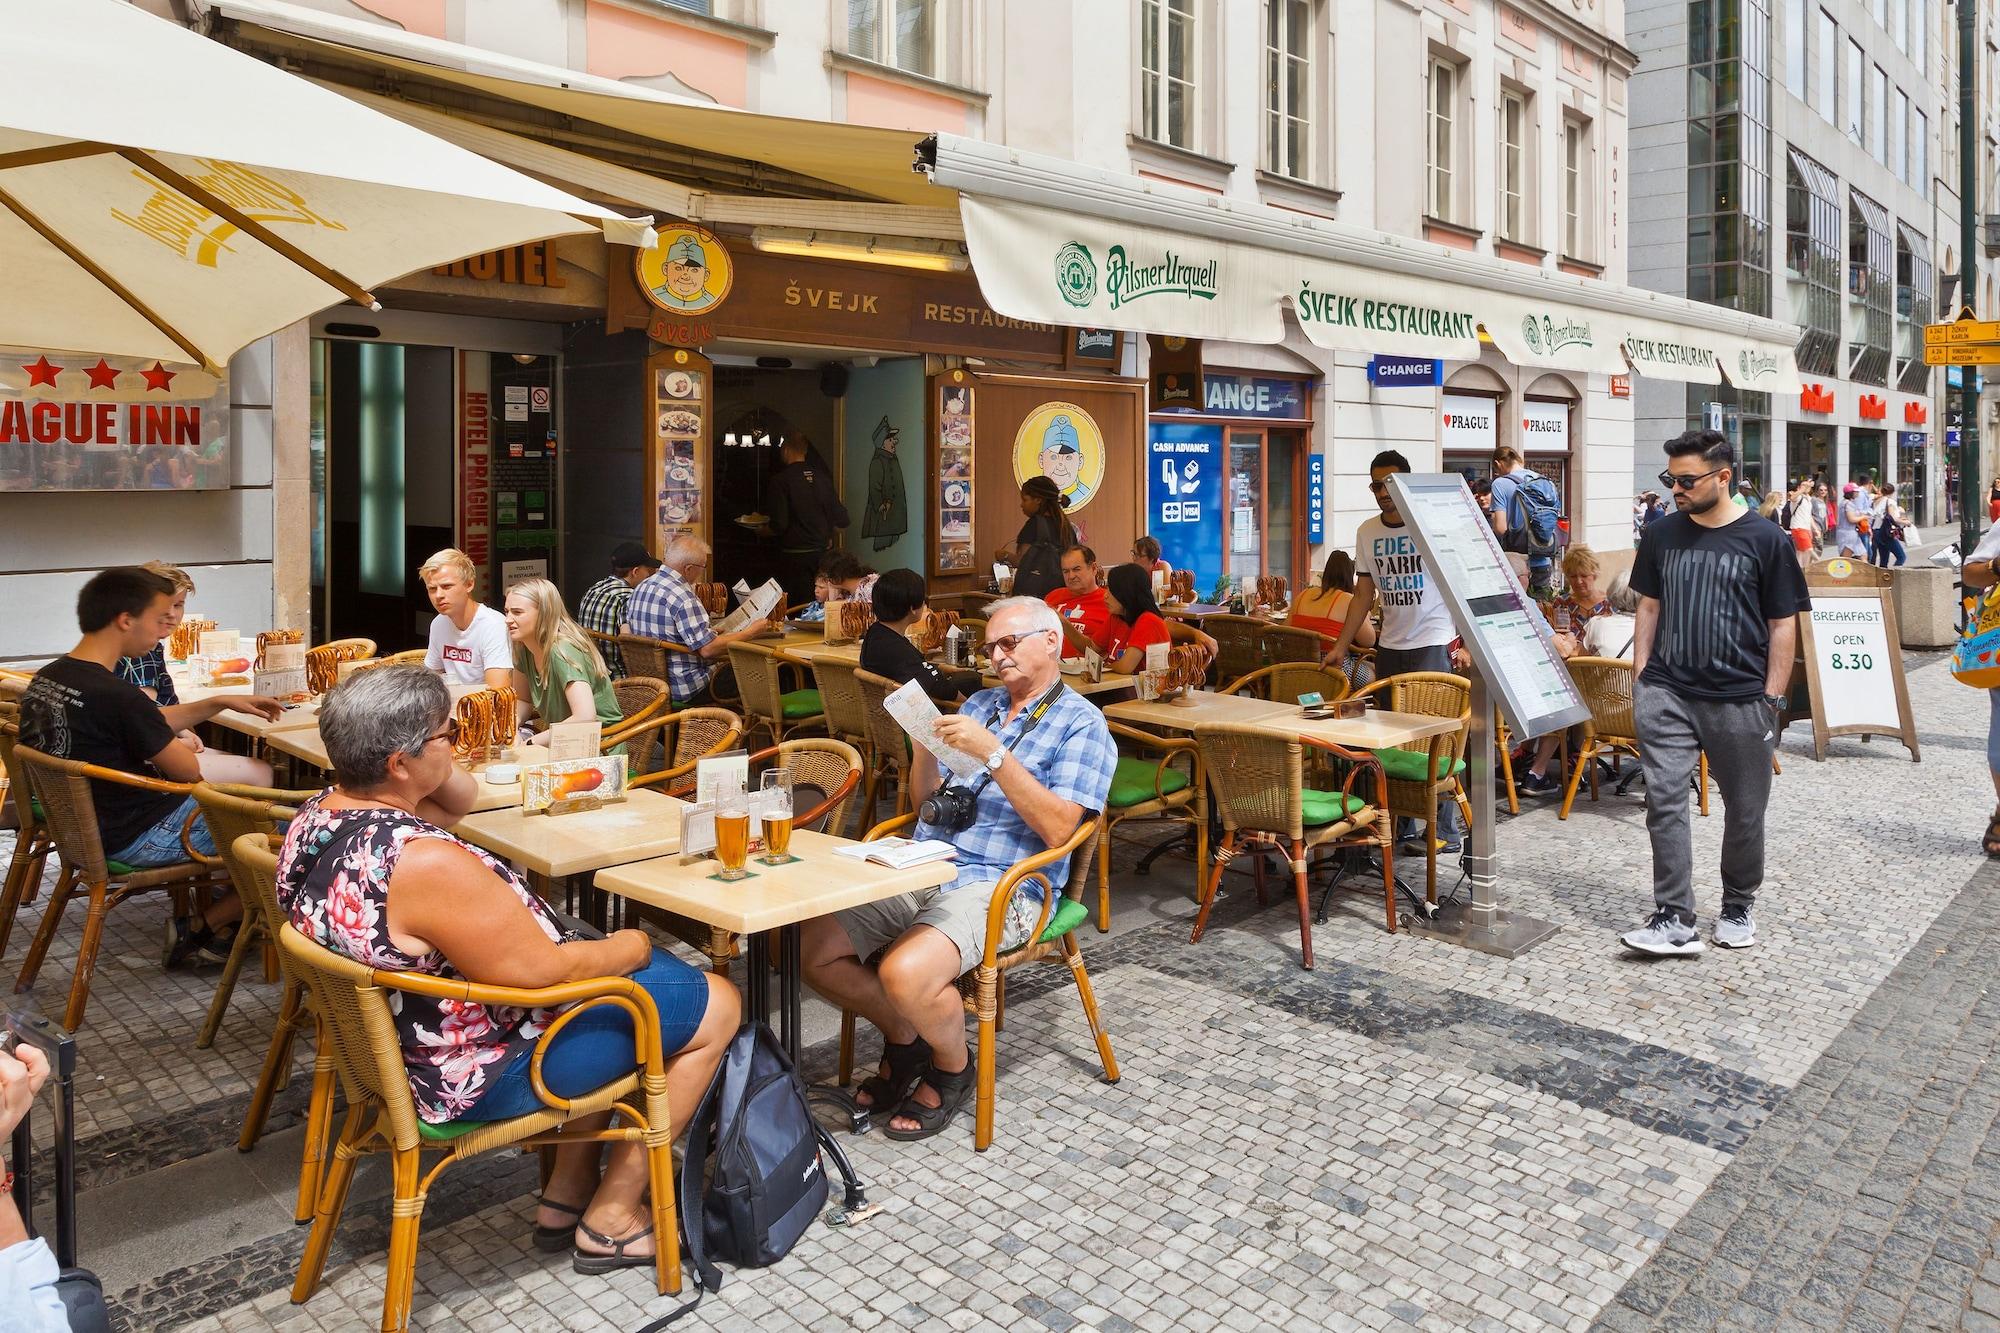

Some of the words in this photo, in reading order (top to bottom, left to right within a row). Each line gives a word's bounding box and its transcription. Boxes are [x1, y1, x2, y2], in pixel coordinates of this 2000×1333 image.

[1107, 245, 1165, 310] Pilsner
[1166, 250, 1217, 300] Urquell
[784, 279, 879, 314] ŠVEJK
[1300, 280, 1358, 327] ŠVEJK
[1363, 299, 1476, 339] RESTAURANT
[1626, 332, 1656, 363] ŠVEJK
[1657, 343, 1715, 369] RESTAURANT
[1378, 364, 1432, 376] CHANGE
[0, 401, 117, 446] AGUE
[129, 404, 200, 446] INN
[467, 393, 488, 448] HOTEL
[1452, 415, 1489, 430] PRAGUE
[1530, 420, 1562, 432] PRAGUE
[1153, 442, 1174, 452] CASH
[1175, 443, 1210, 453] ADVANCE
[467, 453, 488, 527] PRAGUE
[1310, 462, 1321, 533] CHANGE
[467, 533, 488, 567] INN
[1374, 555, 1422, 575] PARK
[1379, 574, 1424, 591] BEACH
[1382, 590, 1424, 606] RUGBY
[1813, 611, 1880, 622] BREAKFAST
[1833, 635, 1865, 645] OPEN
[1831, 653, 1873, 670] 8.30
